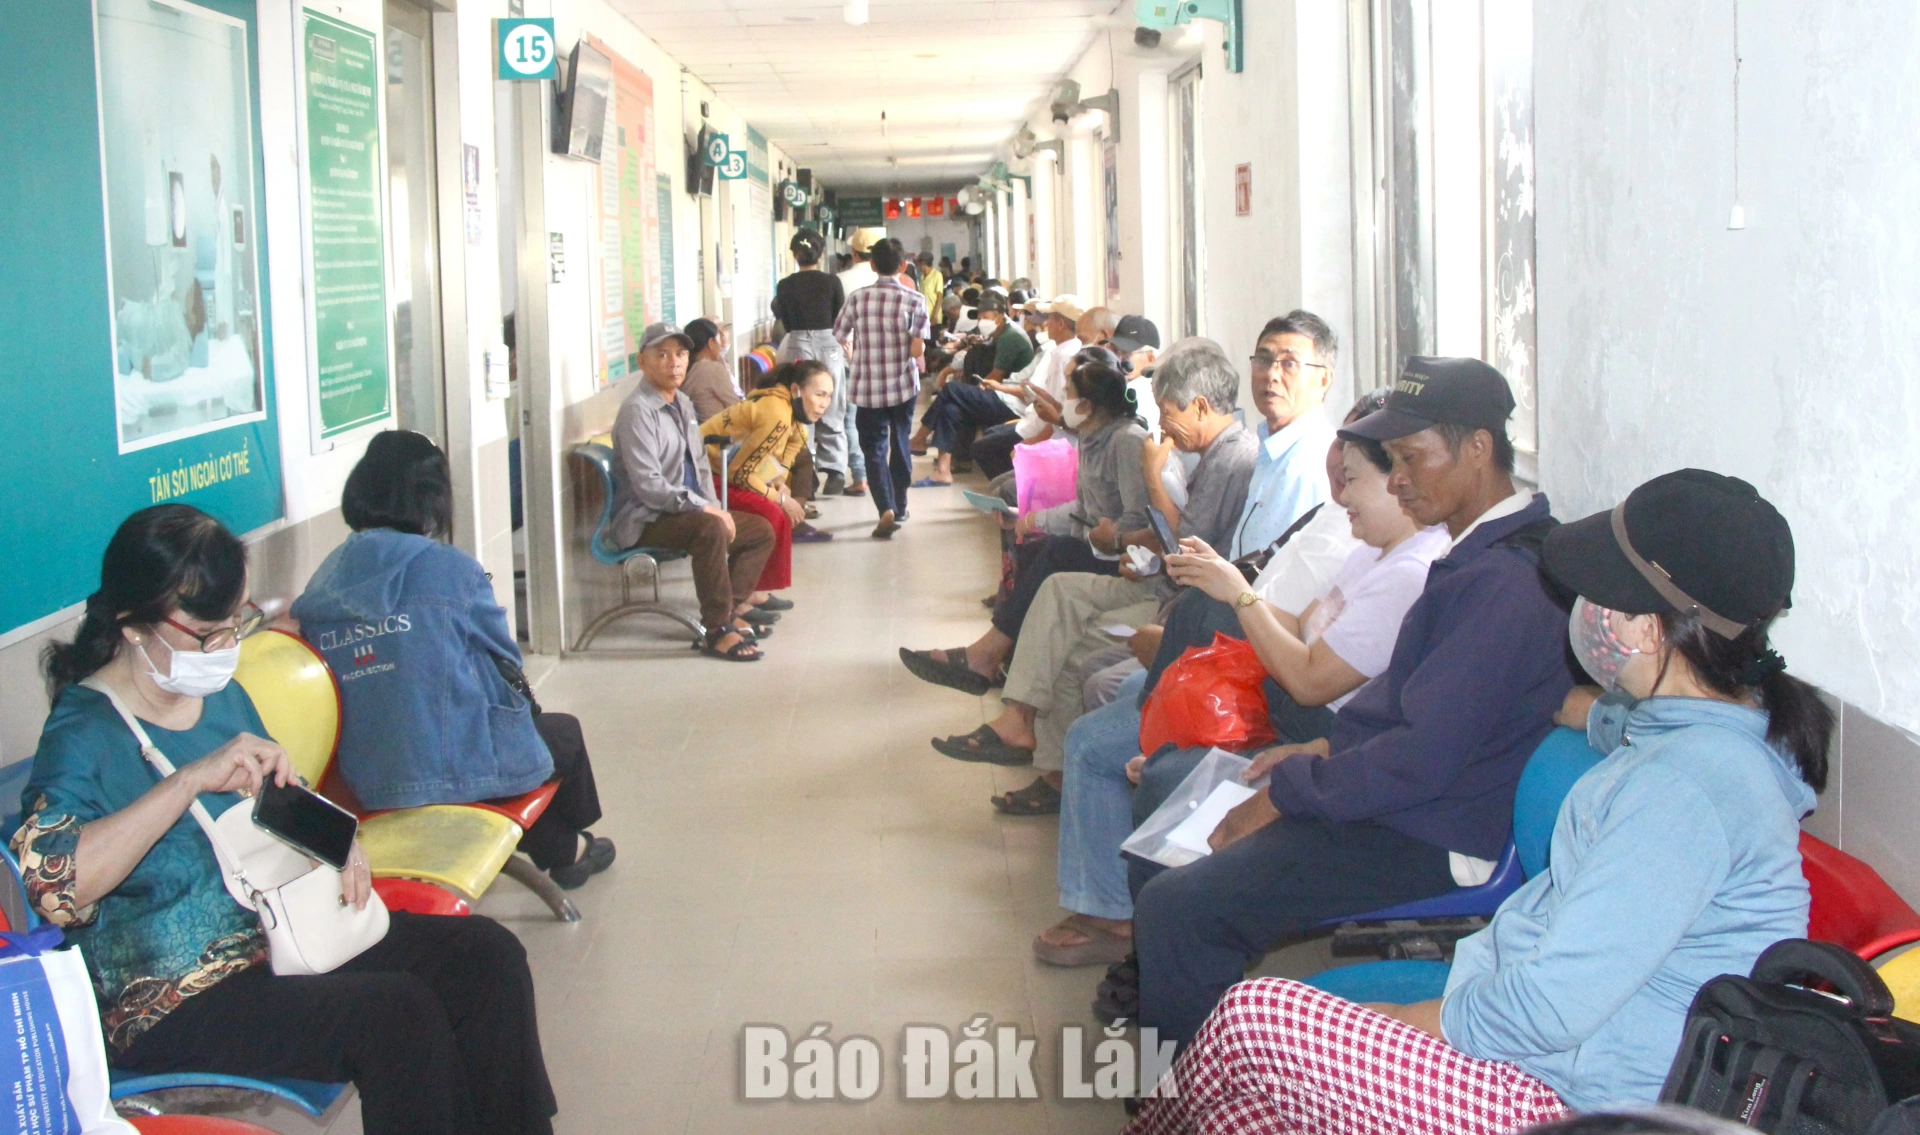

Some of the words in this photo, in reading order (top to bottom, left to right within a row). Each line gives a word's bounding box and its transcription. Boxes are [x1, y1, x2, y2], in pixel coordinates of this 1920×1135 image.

[516, 36, 546, 62] 15
[713, 143, 722, 157] A
[149, 467, 171, 503] TÁN
[172, 458, 189, 497] SỎI
[190, 453, 218, 491] NGOÀI
[219, 451, 232, 482] CƠ
[232, 437, 250, 476] THỂ
[319, 613, 412, 651] CLASSICS
[12, 992, 21, 1017] MINH
[22, 991, 31, 1011] HOUSE
[14, 1018, 25, 1035] CHÍ
[27, 1011, 39, 1048] PUBLISHING
[21, 1052, 29, 1065] TP
[34, 1048, 45, 1082] EDUCATION
[12, 1081, 23, 1101] BẢN
[23, 1065, 34, 1093] PHẠM
[40, 1084, 47, 1092] OF
[41, 1093, 52, 1129] UNIVERSITY
[1740, 1103, 1752, 1119] Kim
[1747, 1082, 1761, 1102] Long
[15, 1103, 27, 1128] XUẤT
[30, 1109, 40, 1129] HỌC
